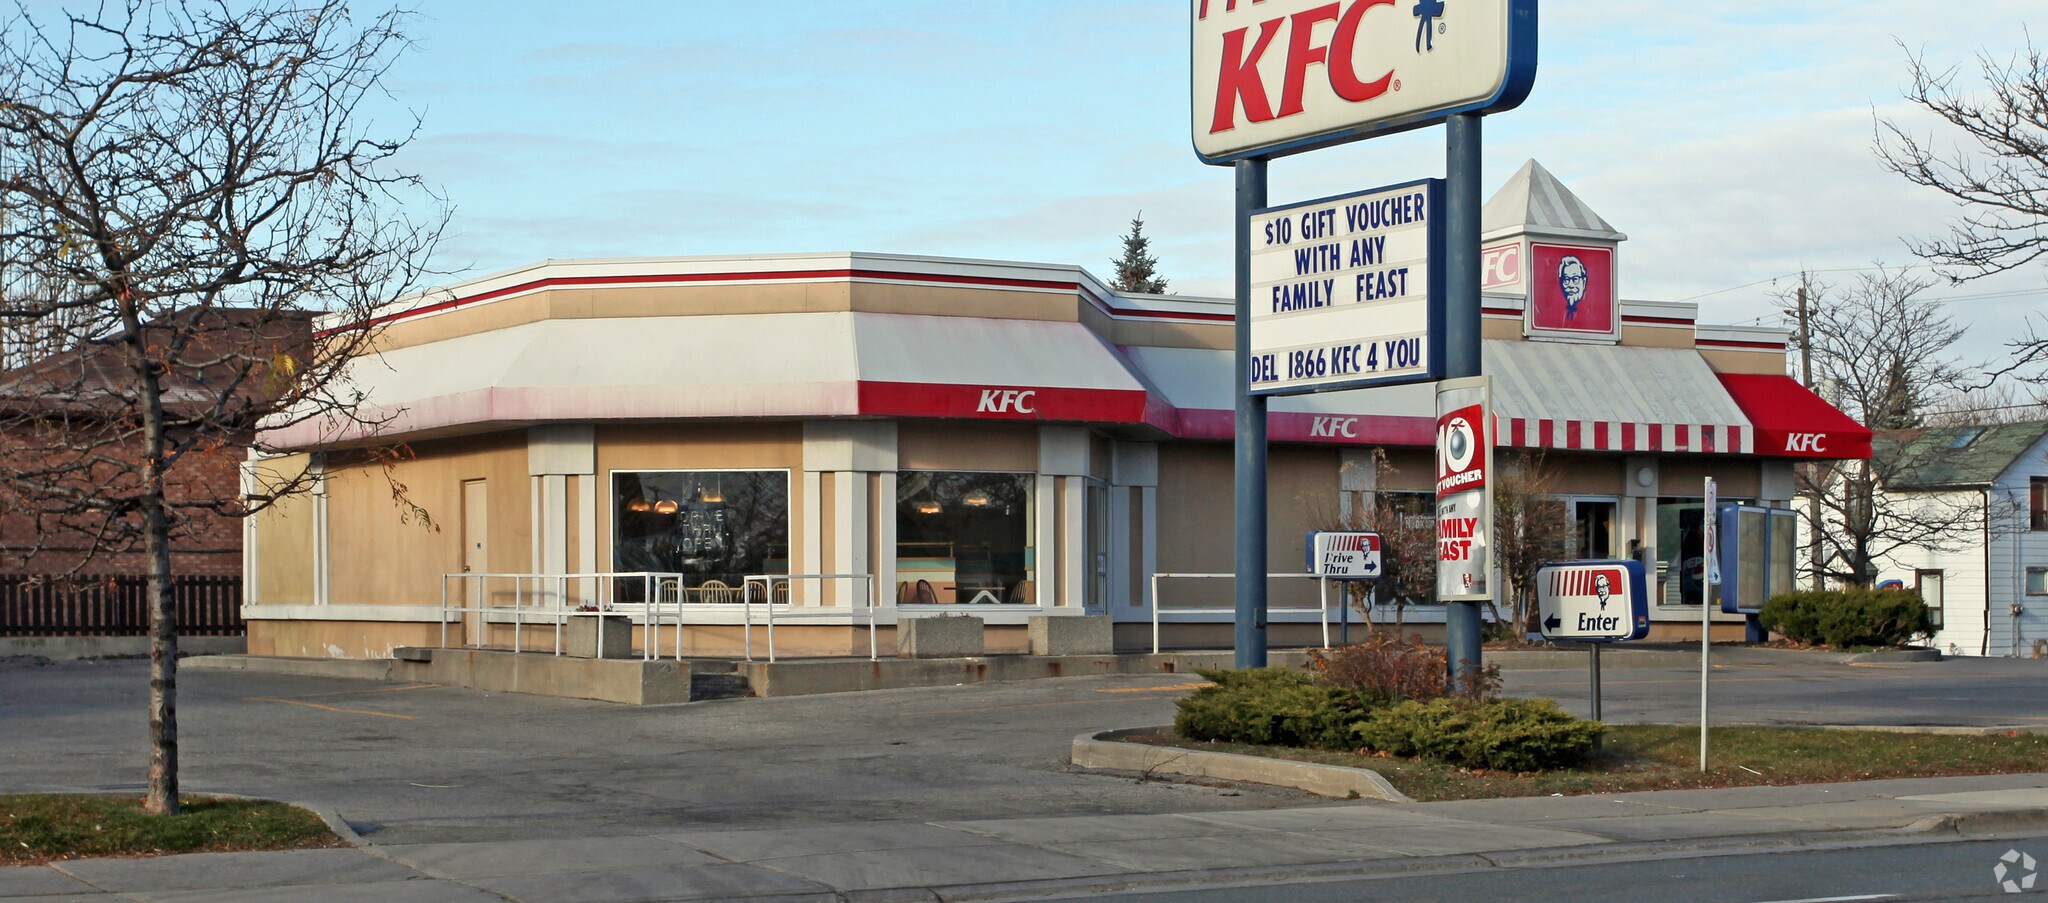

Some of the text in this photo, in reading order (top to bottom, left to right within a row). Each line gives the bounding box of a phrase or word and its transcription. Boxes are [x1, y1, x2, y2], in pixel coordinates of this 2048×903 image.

[1209, 0, 1395, 134] KFC
[1265, 193, 1425, 246] $10 GIFT VOUCHER
[1294, 235, 1386, 276] WITH ANY
[1482, 248, 1518, 285] FC
[1272, 267, 1409, 313] FAMILY FEAST
[1251, 337, 1420, 383] DEL 1866 KFC 4 YOU
[976, 389, 1036, 414] KFC
[1310, 416, 1358, 438] KFC
[1785, 432, 1827, 453] KFC
[1442, 468, 1482, 490] VOUCHER
[1437, 517, 1478, 539] AMILY
[1437, 540, 1472, 561] EAST
[1323, 563, 1349, 574] Thru
[1578, 612, 1620, 631] Enter
